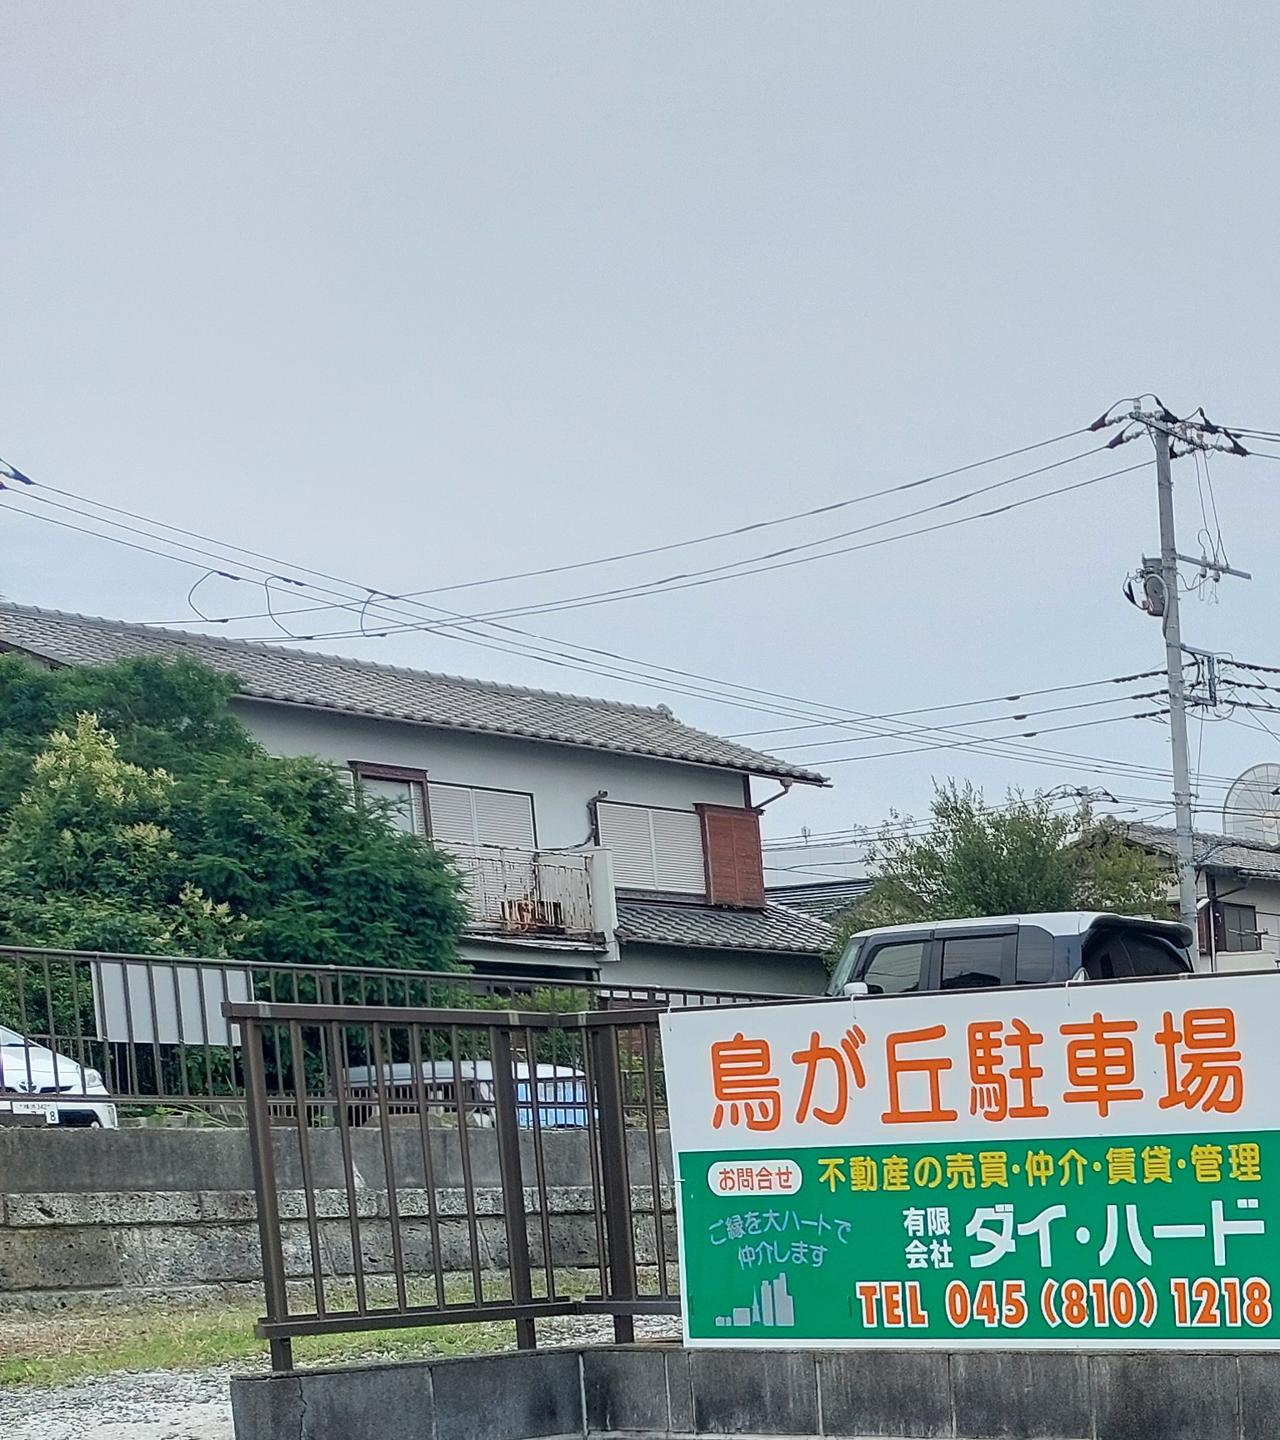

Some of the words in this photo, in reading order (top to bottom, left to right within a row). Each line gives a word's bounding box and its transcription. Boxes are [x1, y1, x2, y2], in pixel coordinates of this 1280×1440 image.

[711, 1007, 1244, 1131] 鳥が丘駐車場
[718, 1166, 793, 1191] お問合せ
[817, 1143, 1262, 1193] 不動産の売買・仲介・賃貸・管理
[708, 1209, 852, 1245] ご縁を大ハートで
[902, 1206, 951, 1238] 有限
[965, 1198, 1265, 1269] ダイ・ハード
[738, 1240, 828, 1271] 仲介します
[904, 1239, 954, 1270] 会社
[855, 1279, 929, 1328] TEL
[945, 1280, 1028, 1328] 045
[1040, 1277, 1157, 1328] (810)
[1170, 1276, 1272, 1327] 1218
